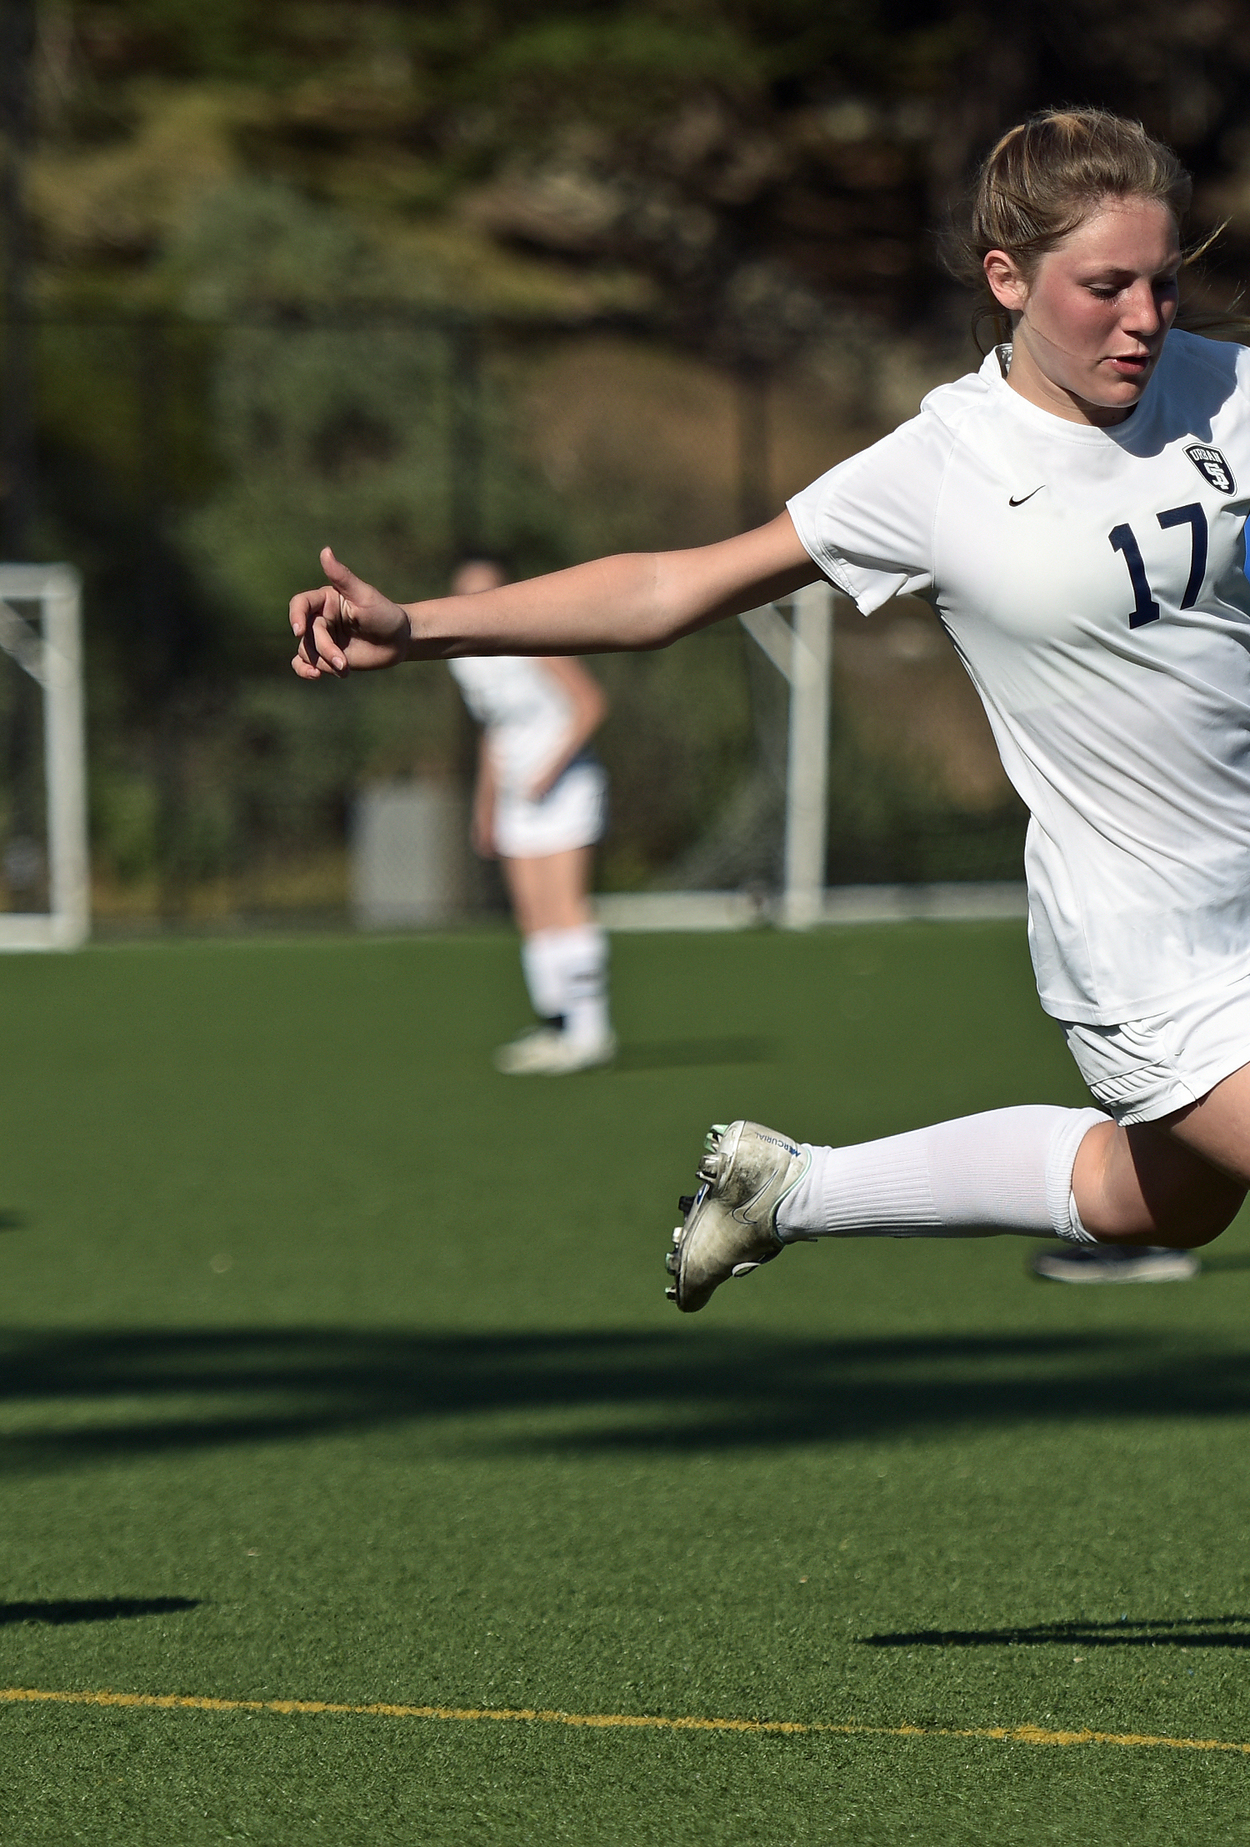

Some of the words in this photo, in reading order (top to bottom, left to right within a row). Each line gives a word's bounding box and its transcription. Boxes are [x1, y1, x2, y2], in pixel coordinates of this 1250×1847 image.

[1189, 448, 1223, 464] URBAN
[1108, 501, 1209, 630] 17
[754, 1131, 802, 1158] MERCURIAL
